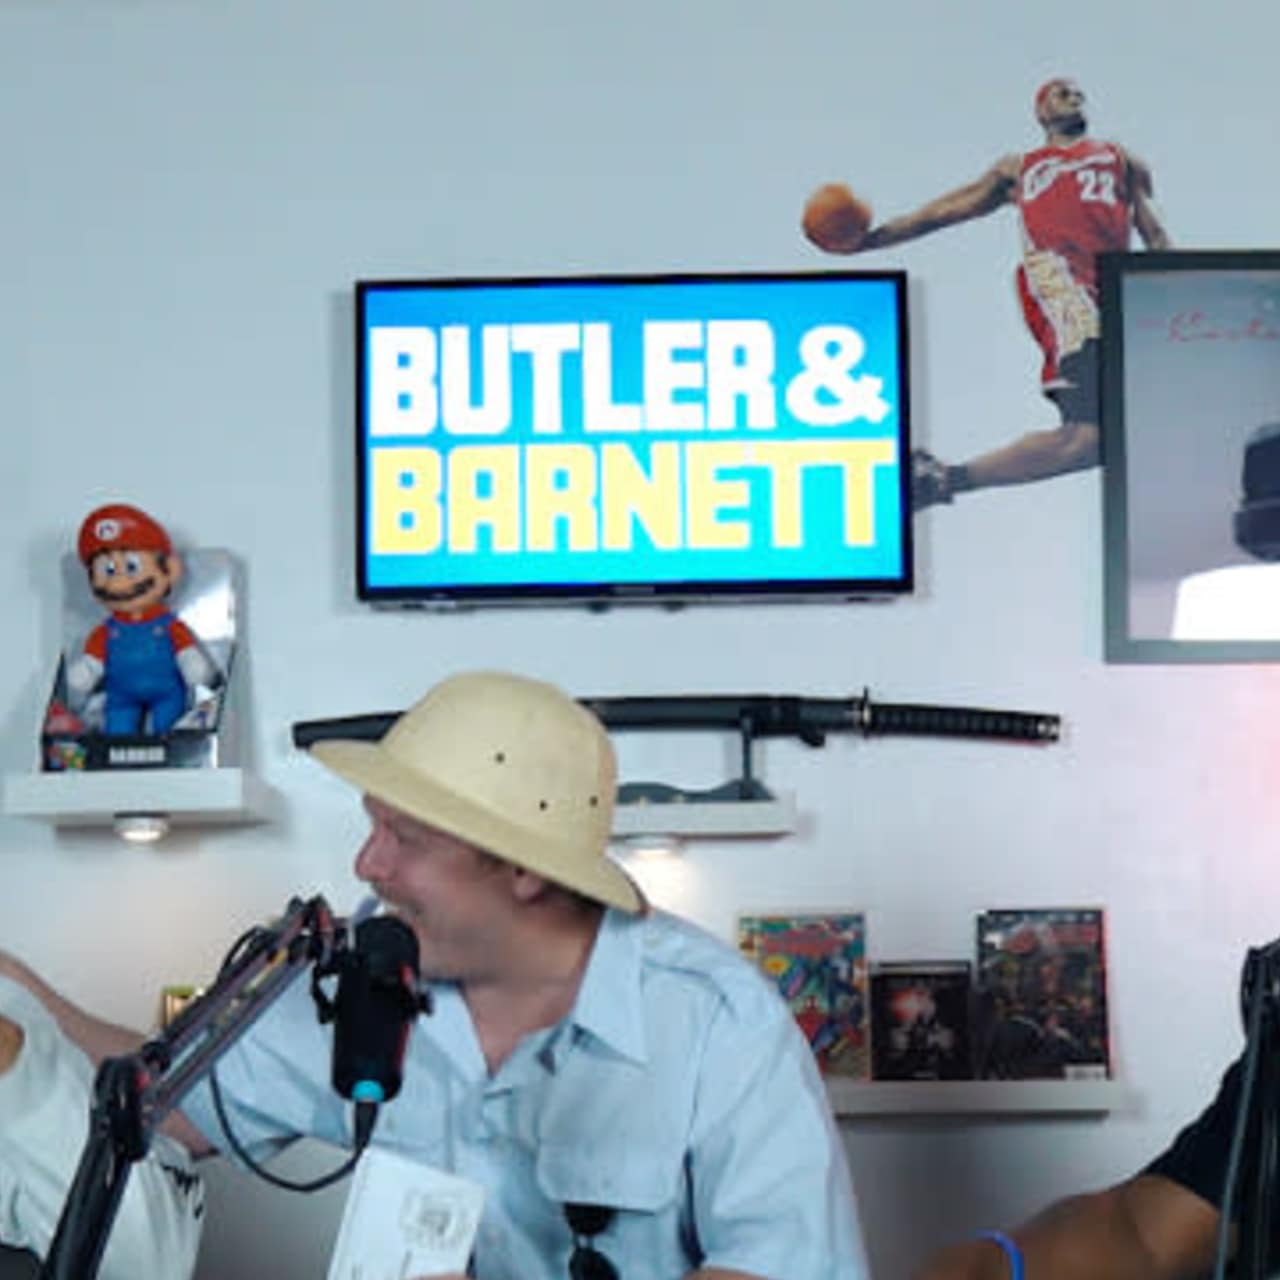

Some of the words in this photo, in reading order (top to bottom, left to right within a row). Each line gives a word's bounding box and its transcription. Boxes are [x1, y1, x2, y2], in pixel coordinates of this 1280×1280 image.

[369, 319, 777, 437] BUTLER
[785, 324, 891, 427] &
[369, 438, 897, 555] BARNETT
